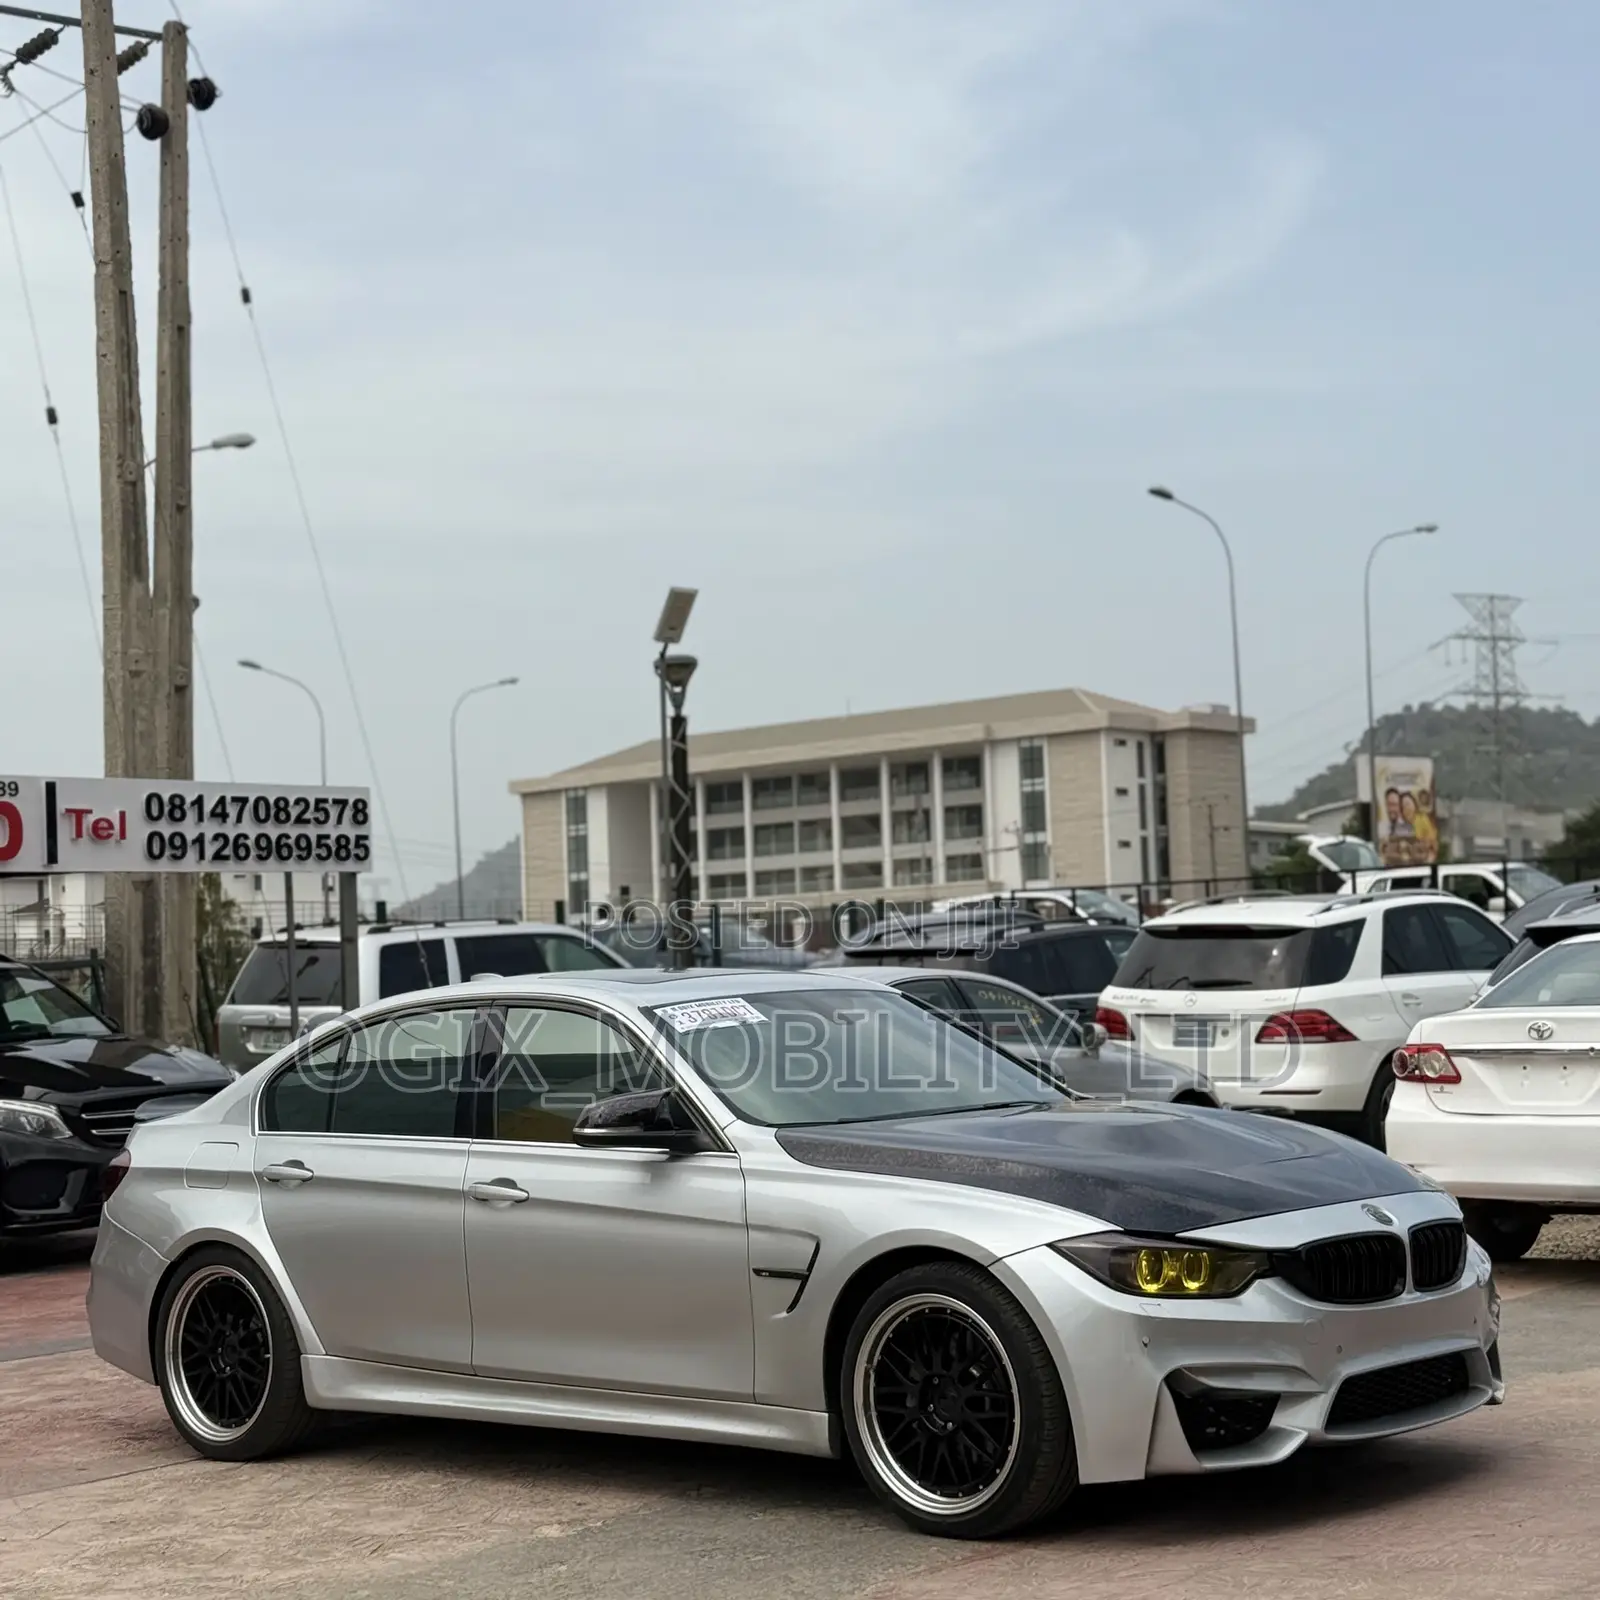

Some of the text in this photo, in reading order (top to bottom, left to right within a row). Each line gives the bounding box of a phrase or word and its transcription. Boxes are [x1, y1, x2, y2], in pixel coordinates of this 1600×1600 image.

[65, 808, 126, 841] Tel
[145, 792, 369, 826] 08147082578
[146, 831, 370, 862] 09126969585
